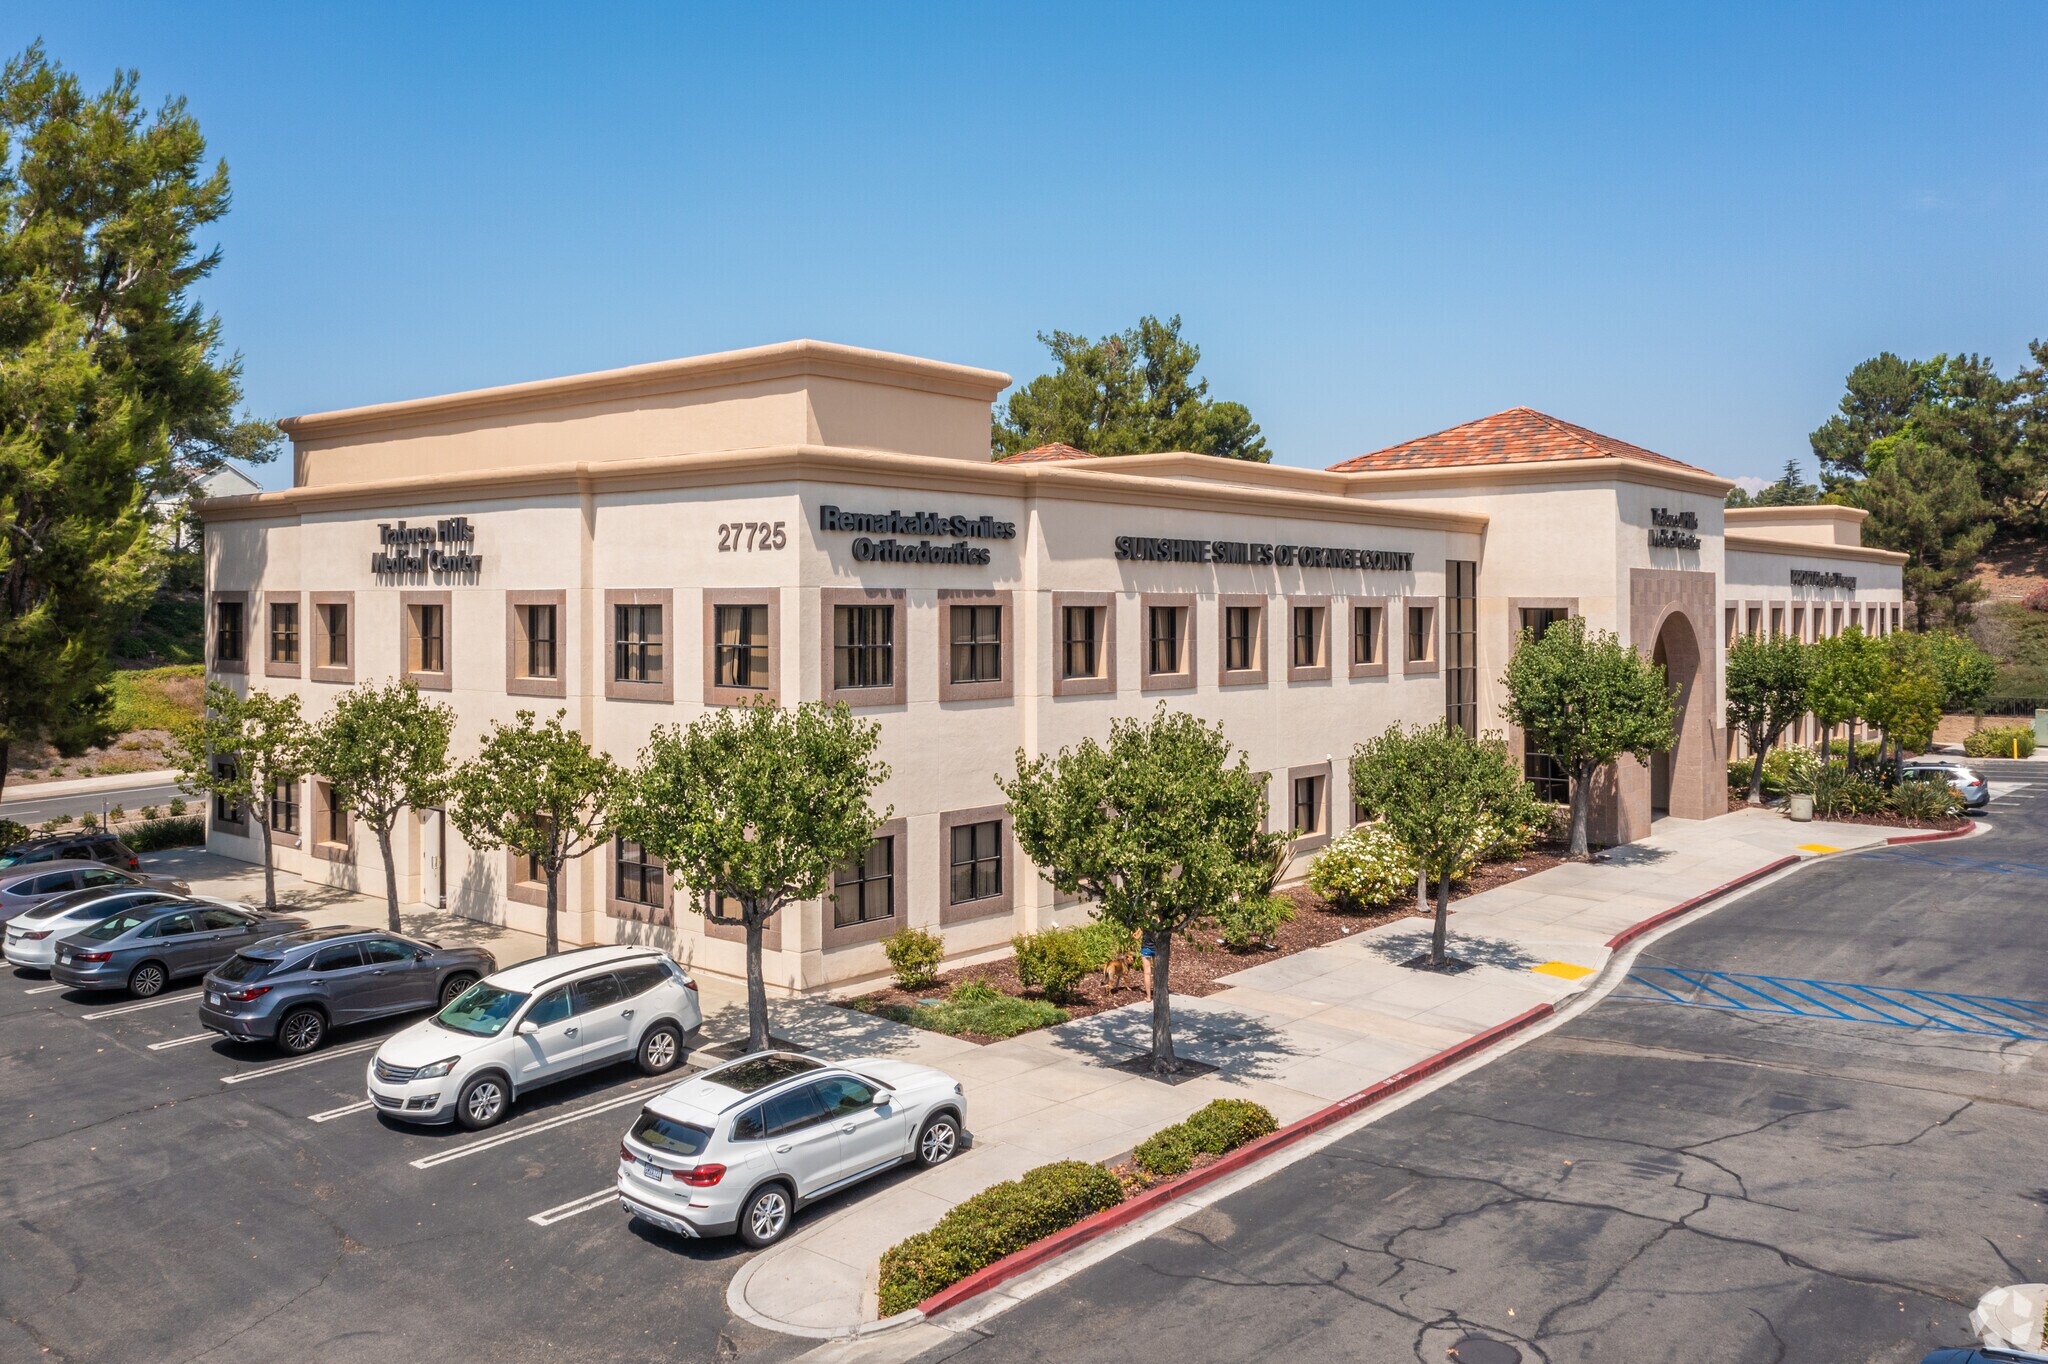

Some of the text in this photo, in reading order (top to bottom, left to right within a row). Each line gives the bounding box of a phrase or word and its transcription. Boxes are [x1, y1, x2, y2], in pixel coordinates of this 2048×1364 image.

[378, 517, 475, 545] Trabuco Hills
[718, 521, 786, 552] 27725
[820, 505, 1016, 539] Remarkable Smiles
[371, 549, 482, 574] Medical Center
[852, 537, 991, 565] Orthodontics
[1114, 535, 1415, 571] SUNSHINE SMILES OF ORANGE COUNTY
